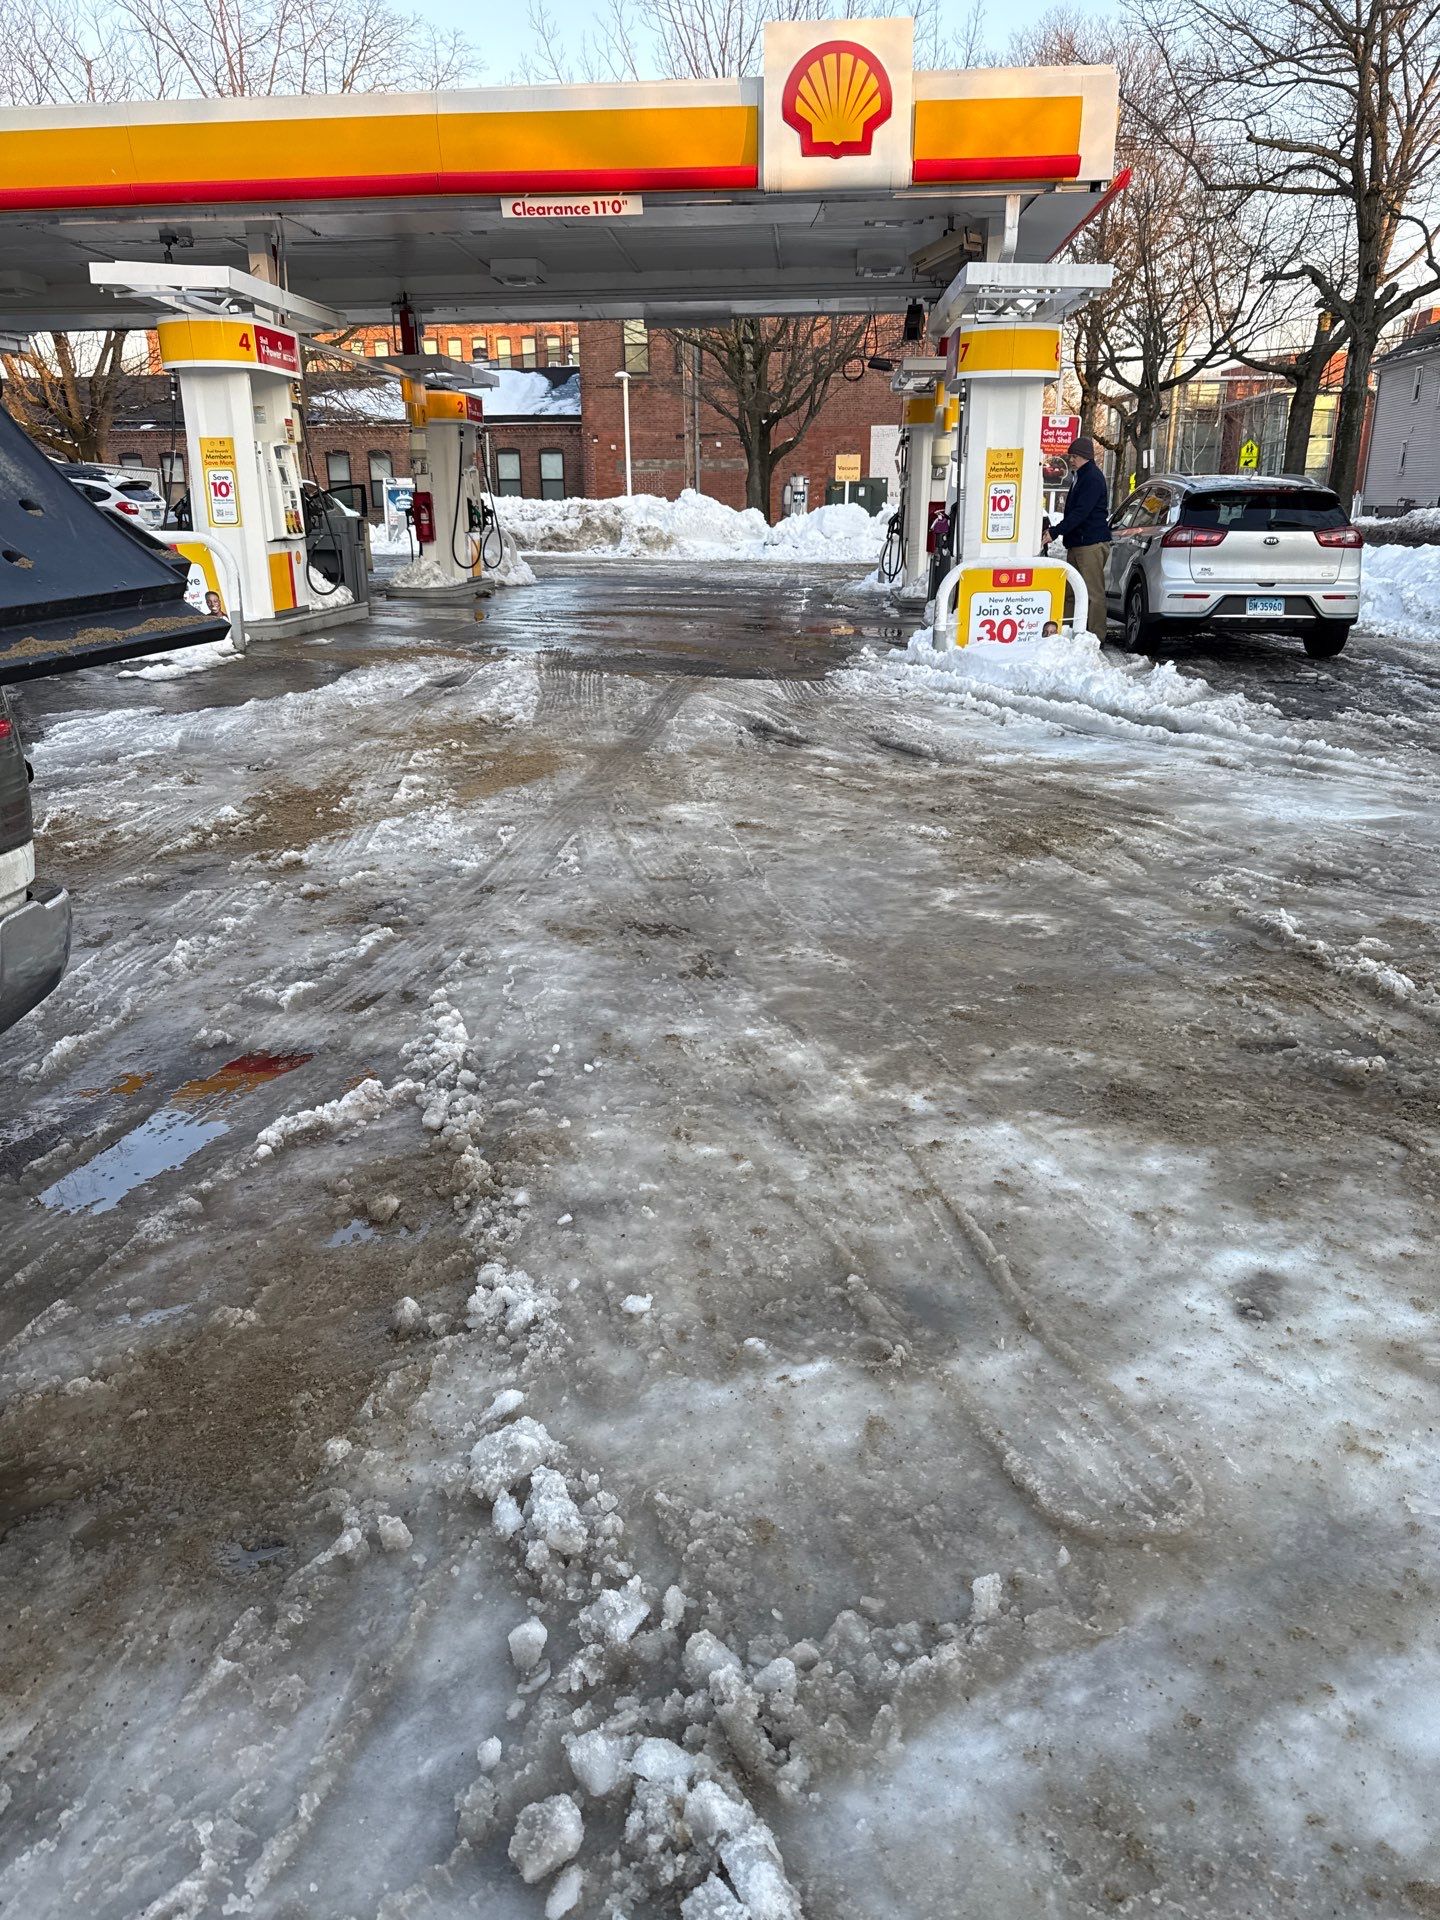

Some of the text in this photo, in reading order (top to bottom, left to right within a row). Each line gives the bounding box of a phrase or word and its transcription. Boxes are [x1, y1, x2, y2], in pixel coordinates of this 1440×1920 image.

[511, 200, 628, 216] Clearance 11'0"
[239, 333, 251, 351] 4
[960, 343, 970, 362] 7
[457, 401, 464, 413] 2
[1055, 429, 1072, 437] More
[1056, 436, 1072, 444] Shell
[993, 487, 1011, 495] Save
[187, 578, 201, 586] ve
[976, 604, 1044, 617] Join & Save
